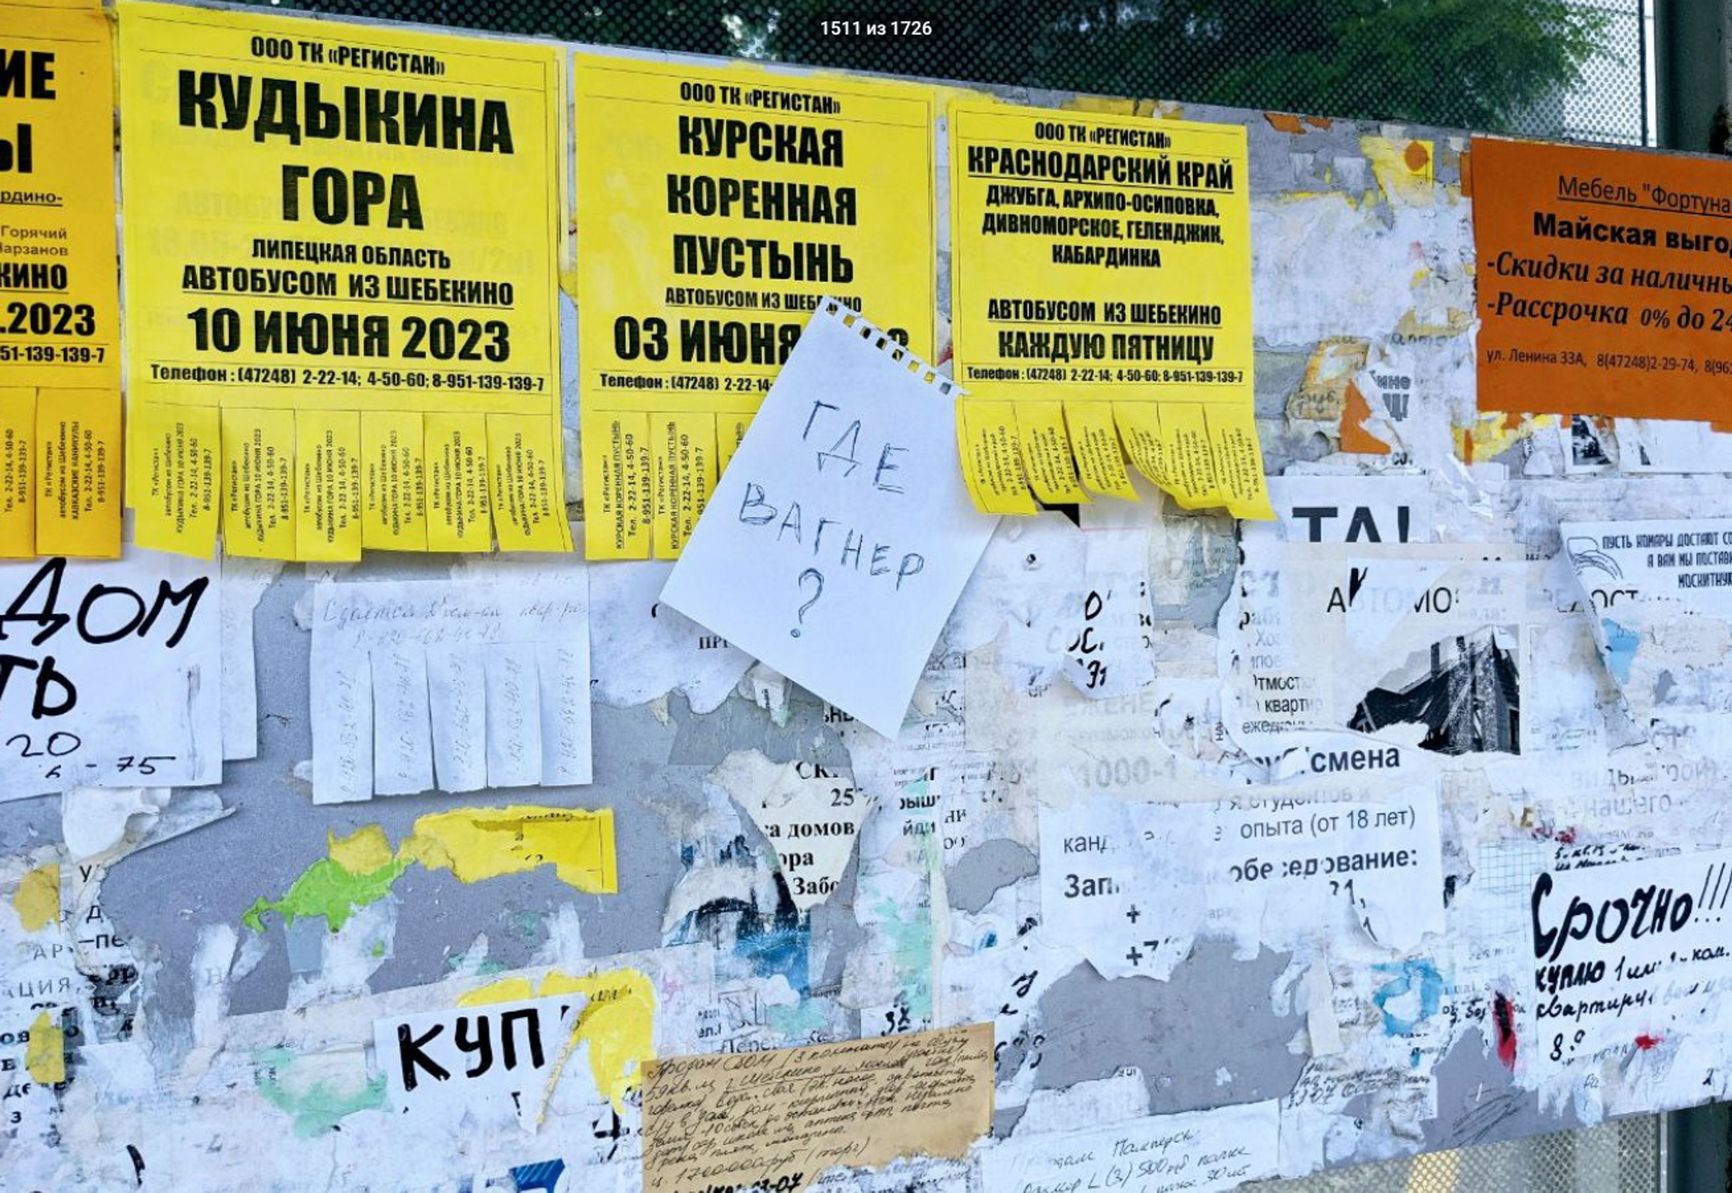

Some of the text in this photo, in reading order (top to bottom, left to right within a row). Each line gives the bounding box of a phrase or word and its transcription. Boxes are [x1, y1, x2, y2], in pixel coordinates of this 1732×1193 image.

[251, 36, 446, 76] ООО ТК «РЕГИСТАН»
[178, 70, 514, 155] КУДЫКИНА
[680, 82, 840, 115] ООО ТК «РЕГИСТАН»
[678, 115, 844, 168] КУРСКАЯ
[1035, 122, 1171, 149] ООО ТК «РЕГИСТАН»
[968, 145, 1234, 190] КРАСНОДАРСКИЙ КРАЙ
[282, 164, 425, 231] ГОРА
[667, 173, 857, 226] КОРЕННАЯ
[986, 184, 1220, 218] ДЖУБГА, АРХИПО-ОСИПОВКА,
[1558, 175, 1731, 214] Мебель "Фортуна
[1, 225, 67, 240] Горячий
[982, 213, 1225, 245] ДИВНОМОРСКОЕ, ГЕЛЕНДЖИК,
[1533, 211, 1732, 258] Майская выго
[252, 238, 451, 270] ЛИПЕЦКАЯ ОБЛАСТЬ
[673, 233, 854, 284] ПУСТЫНЬ
[1052, 244, 1161, 269] КАБАРДИНКА
[1487, 251, 1589, 283] -Скидки
[1595, 265, 1624, 285] за
[182, 264, 514, 305] АВТОБУСОМ ИЗ ШЕБЕКИНО
[665, 287, 759, 308] АВТОБУСОМ
[761, 291, 780, 309] ИЗ
[988, 298, 1221, 325] АВТОБУСОМ ИЗ ШЕБЕКИНО
[1487, 291, 1629, 326] -Рассрочка
[1640, 308, 1670, 329] 0%
[1677, 304, 1705, 330] до
[187, 307, 510, 363] 10 ИЮНЯ 2023
[614, 316, 669, 362] 03
[679, 319, 802, 365] ИЮНЯ
[998, 331, 1214, 365] КАЖДУЮ ПЯТНИЦУ
[1026, 368, 1067, 382] (47248)
[1071, 369, 1112, 382] 2-22-14;
[1117, 370, 1162, 383] 4-50-60;
[1163, 370, 1243, 383] 8-951-139-139-7
[1487, 350, 1505, 365] ул.
[1509, 349, 1557, 365] Ленина
[1560, 351, 1587, 367] 33А,
[238, 367, 296, 385] (47248)
[302, 369, 362, 387] 2-22-14;
[367, 371, 429, 389] 4-50-60;
[432, 373, 544, 391] 8-951-139-139-7
[671, 374, 719, 391] (47248)
[625, 433, 635, 470] 4-50-60
[680, 434, 690, 470] 4-50-60
[802, 400, 911, 495] ГДЕ
[626, 472, 637, 511] 2-22-14,
[681, 472, 692, 511] 2-22-14,
[739, 481, 925, 592] ВАГНЕР
[1602, 535, 1632, 550] ПУСТЬ
[1636, 533, 1673, 548] КОМАРЫ
[1677, 532, 1719, 548] ДОСТАЮТ
[1647, 554, 1654, 568] А
[1657, 553, 1675, 567] ВАМ
[1678, 553, 1693, 566] МЫ
[0, 557, 209, 649] ДОМ
[789, 567, 825, 639] ?
[6, 731, 81, 757] 20
[787, 821, 855, 839] домов
[1239, 805, 1416, 840] опыта (от 18 лет)
